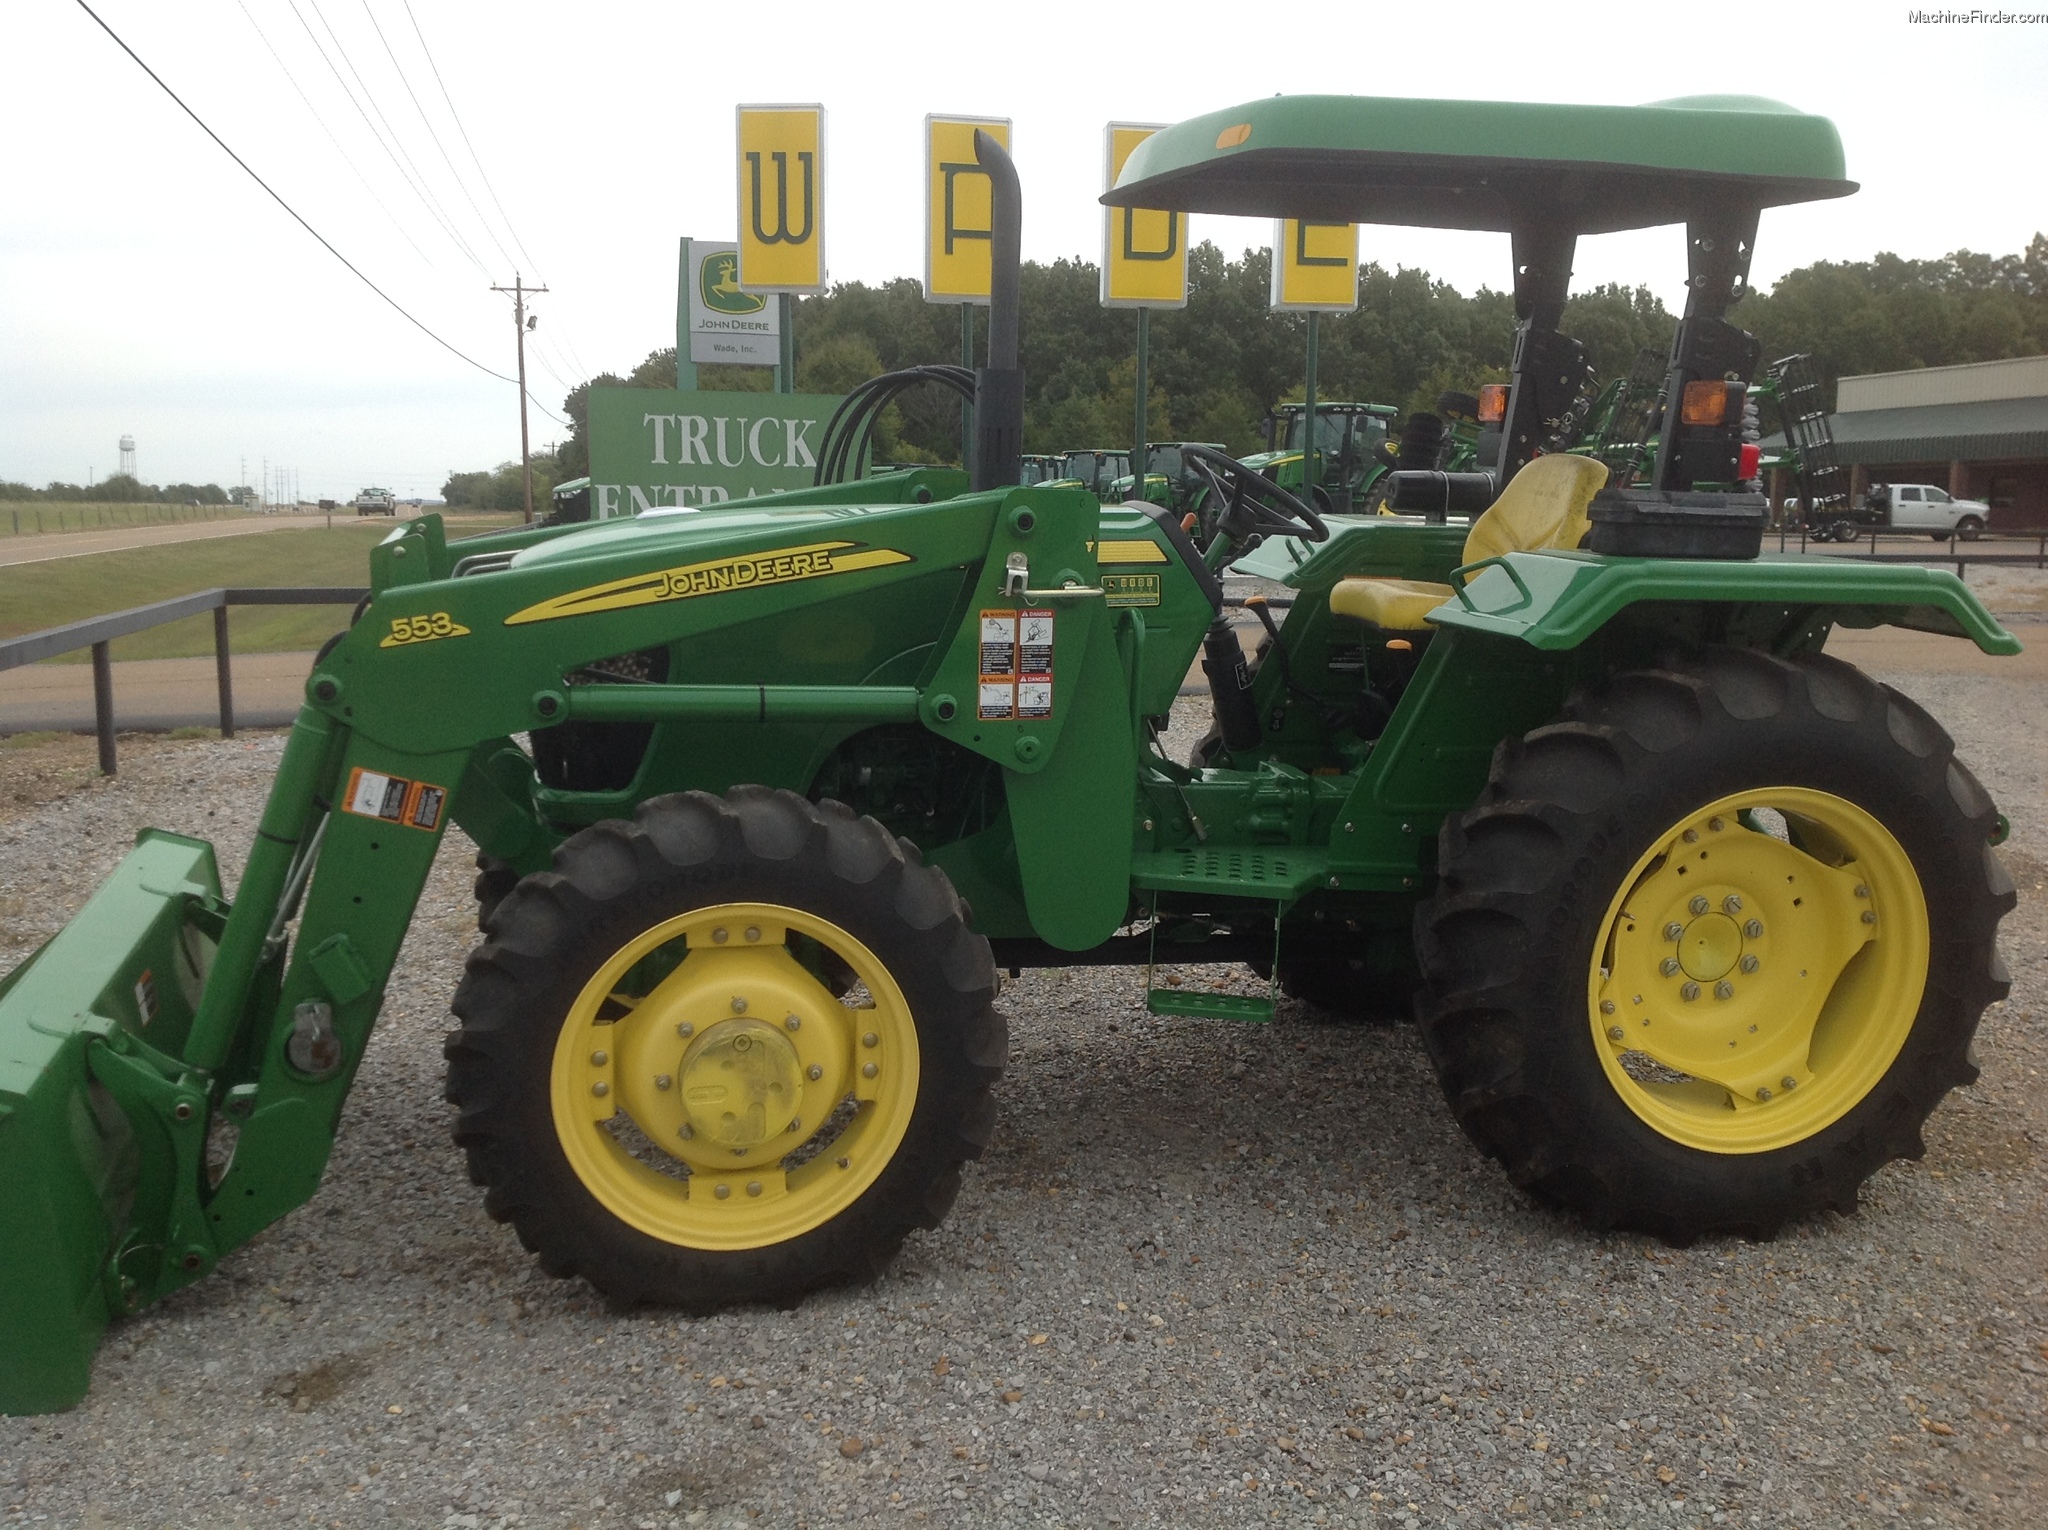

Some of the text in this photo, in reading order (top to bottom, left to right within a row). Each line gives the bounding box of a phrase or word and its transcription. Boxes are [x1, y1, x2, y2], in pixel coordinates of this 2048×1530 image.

[745, 151, 813, 245] W
[713, 344, 757, 353] Wade, Inc.
[643, 413, 818, 468] TRUCK
[391, 611, 455, 641] 553
